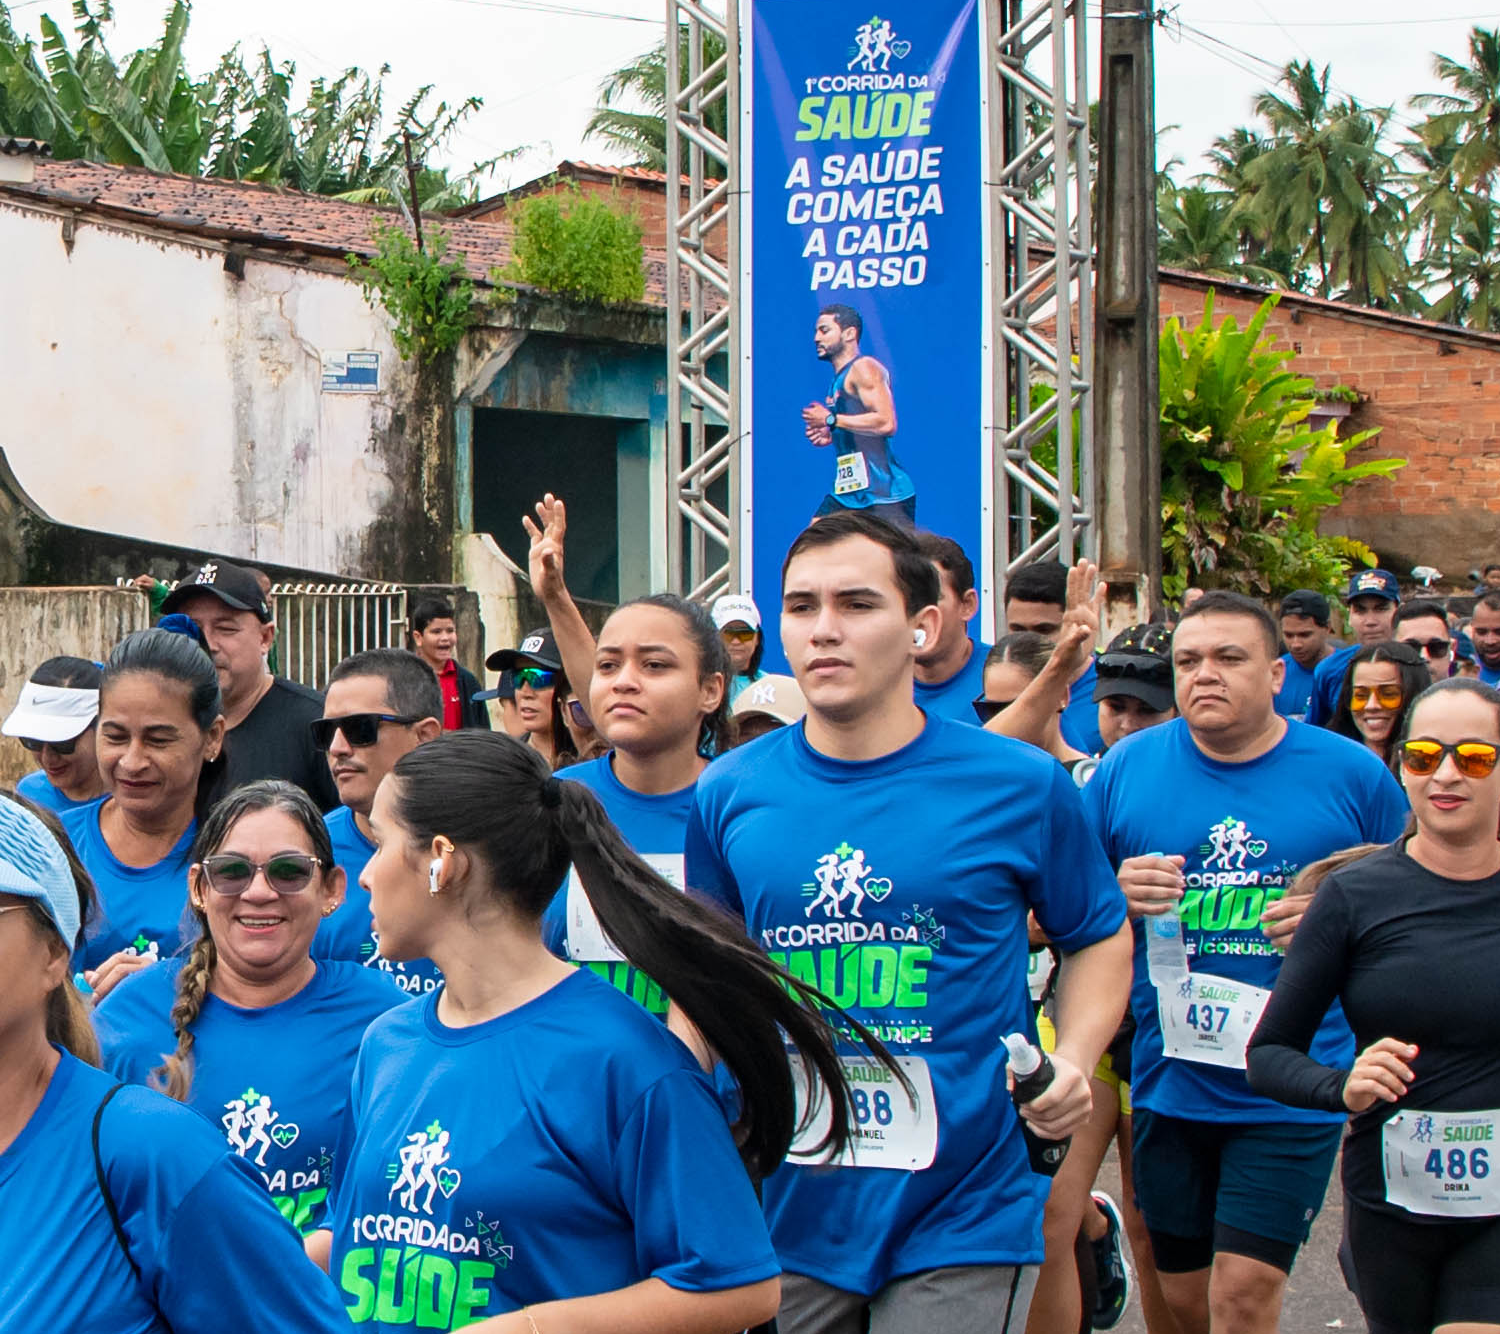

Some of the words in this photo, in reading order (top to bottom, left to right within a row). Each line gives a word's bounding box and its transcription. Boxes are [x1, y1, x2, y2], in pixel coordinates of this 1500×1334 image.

[817, 72, 904, 93] CORRIDA
[908, 75, 929, 89] DA
[795, 90, 936, 142] SAÚDE
[784, 157, 811, 189] A
[820, 142, 944, 187] SAÚDE
[786, 184, 944, 226] COMEÇA
[801, 227, 827, 259] A
[835, 221, 930, 257] CADA
[810, 255, 927, 291] PASSO
[1183, 871, 1259, 888] ORRIDA
[775, 922, 886, 947] CORRIDA
[890, 926, 918, 942] DA
[1186, 1003, 1230, 1033] 437
[1424, 1147, 1490, 1180] 486
[292, 1169, 319, 1189] DA
[1444, 1183, 1470, 1192] DRIKA
[449, 1233, 480, 1255] DA
